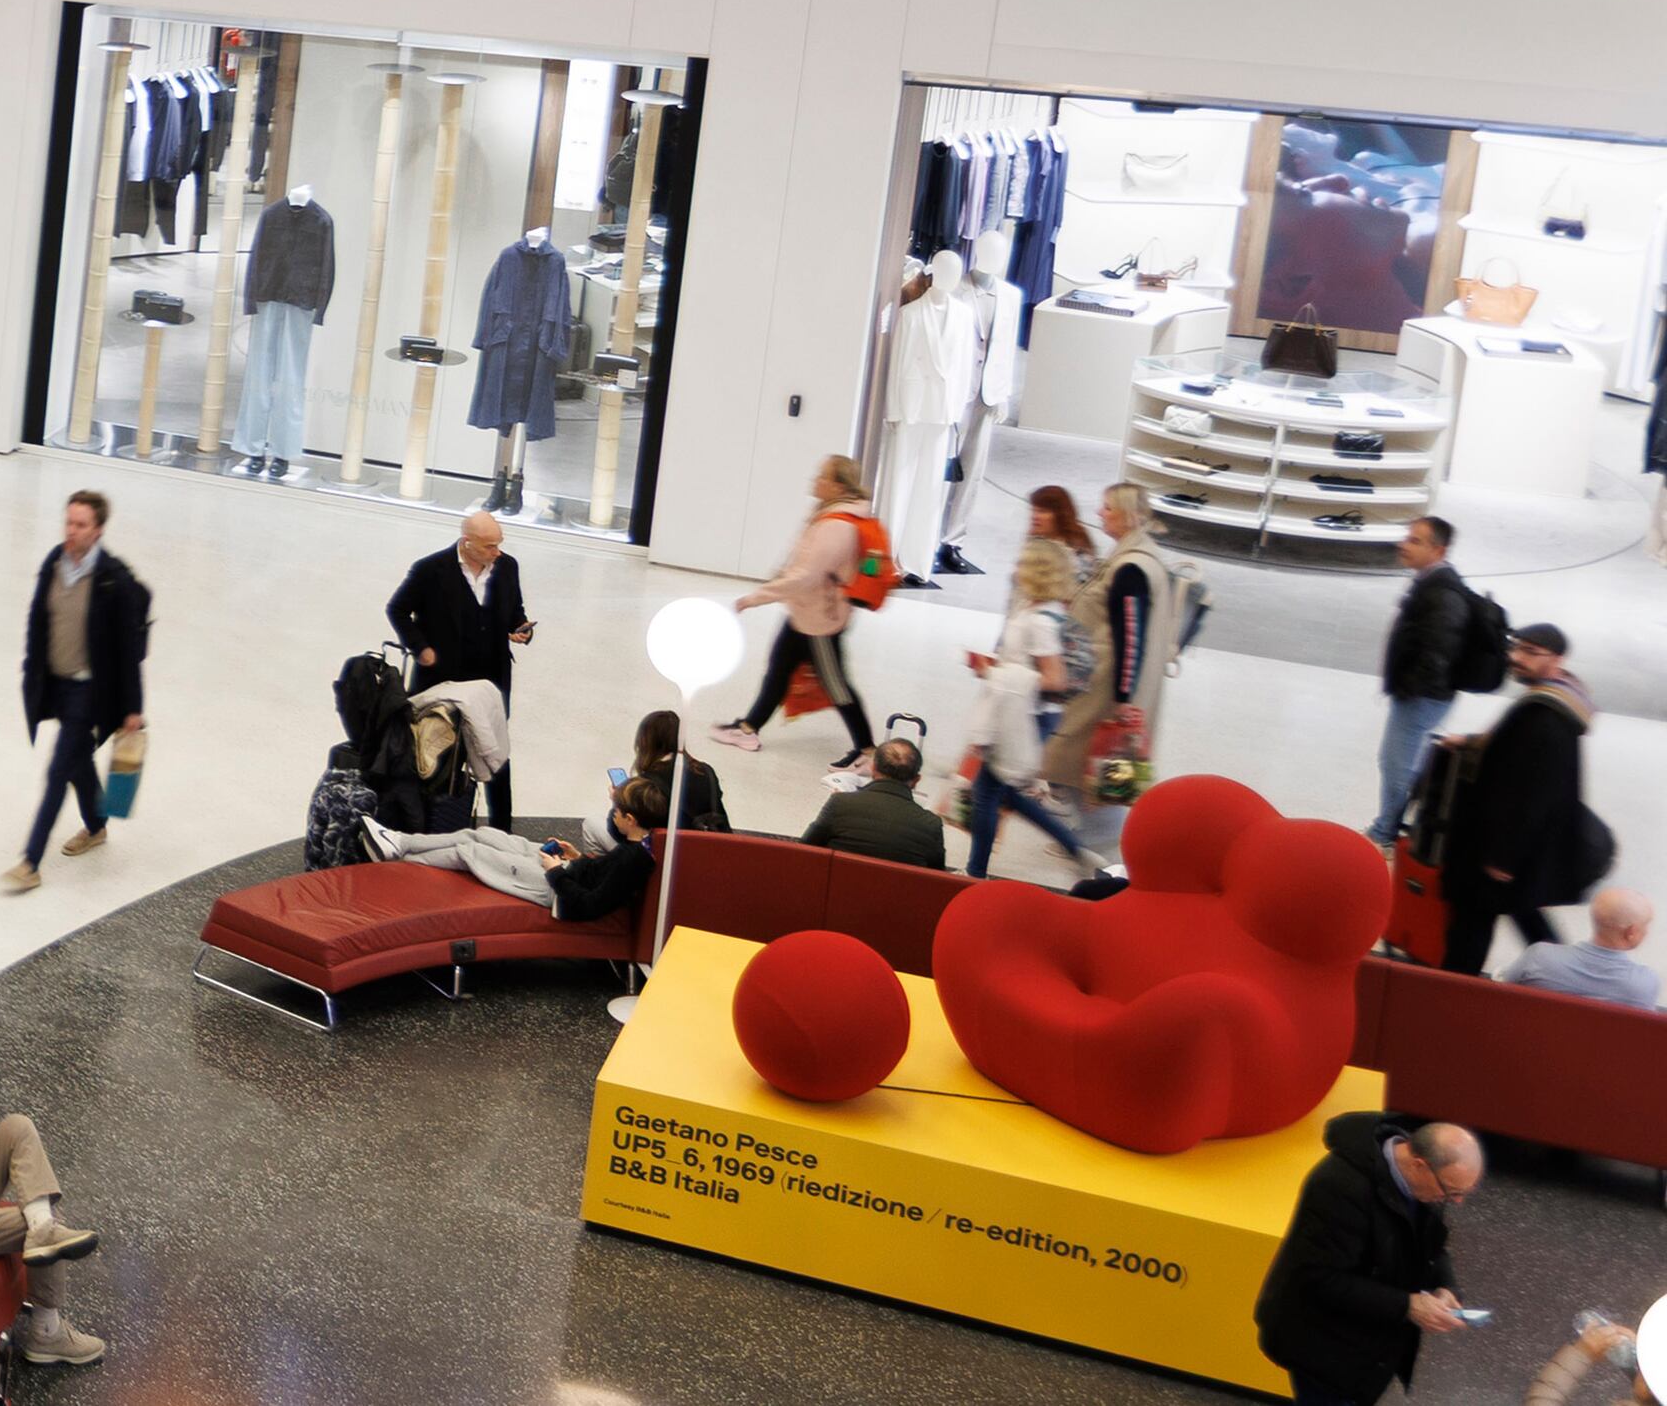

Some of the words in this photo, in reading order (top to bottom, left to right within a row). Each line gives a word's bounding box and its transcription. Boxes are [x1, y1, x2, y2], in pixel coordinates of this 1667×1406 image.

[614, 1104, 730, 1149] Gaetano
[734, 1131, 819, 1170] Pesce
[608, 1155, 668, 1187] B&B
[673, 1170, 741, 1205] Italia
[712, 1154, 776, 1187] 1969
[779, 1170, 925, 1223] (riedizione
[943, 1209, 1099, 1269] re-edition,
[1103, 1246, 1190, 1290] 2000)
